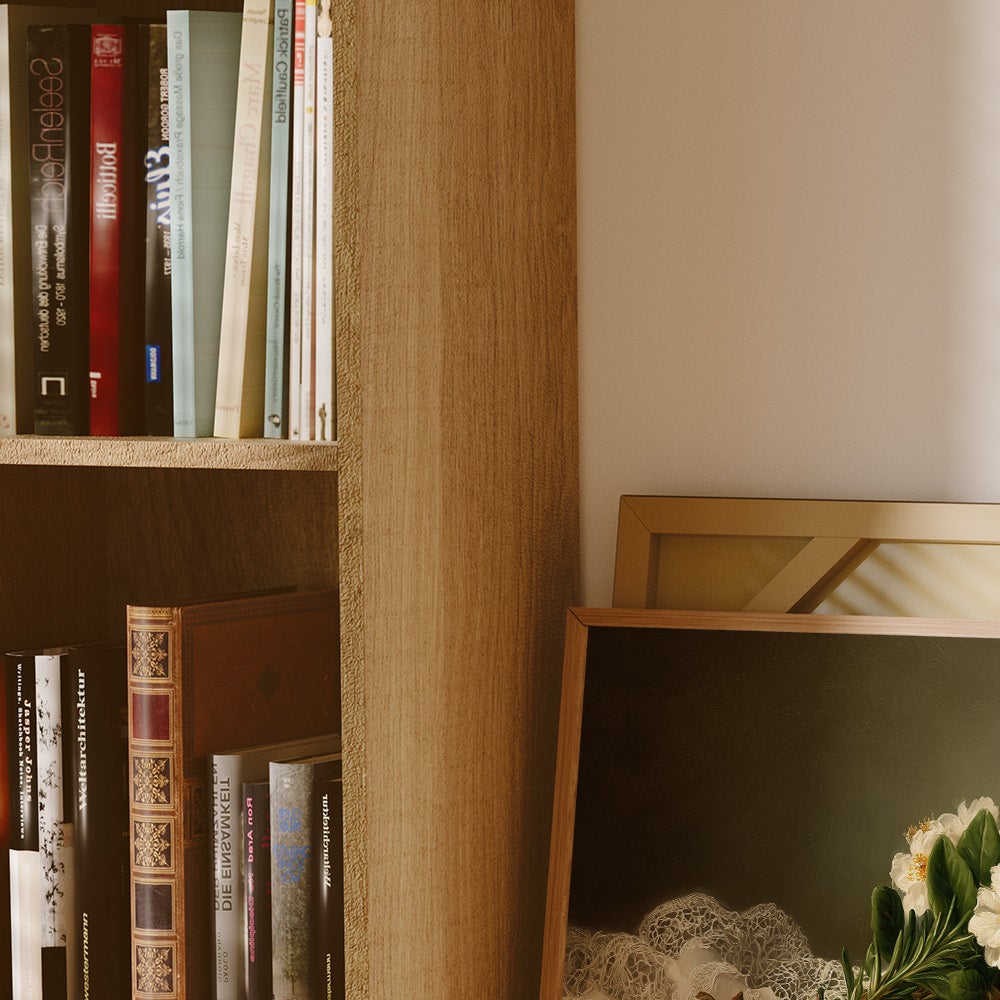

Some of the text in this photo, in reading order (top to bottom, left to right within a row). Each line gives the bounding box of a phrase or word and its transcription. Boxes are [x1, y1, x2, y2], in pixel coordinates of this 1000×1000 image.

[22, 699, 33, 802] Jasper Johns
[76, 667, 87, 811] Weltarchitektur
